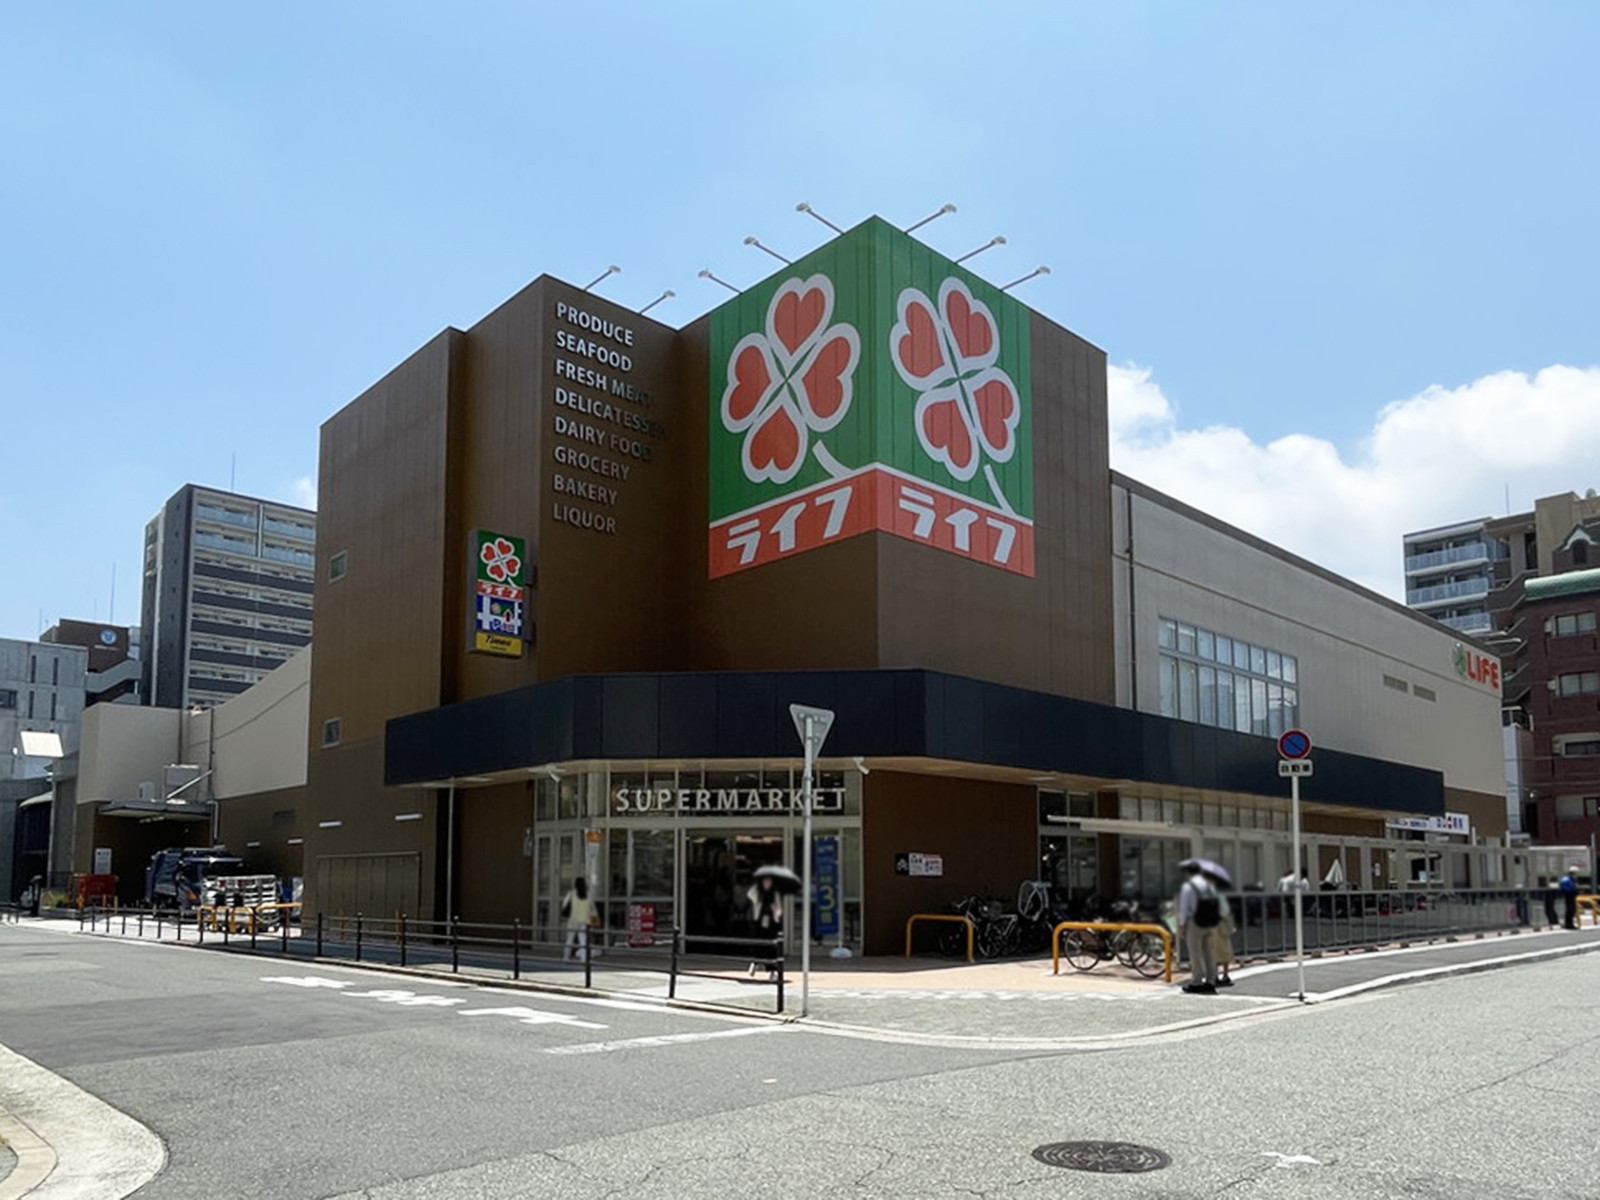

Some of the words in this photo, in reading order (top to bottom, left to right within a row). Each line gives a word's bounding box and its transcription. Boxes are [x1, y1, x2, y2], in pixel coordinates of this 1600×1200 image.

[556, 301, 634, 347] PRODUCE
[555, 330, 633, 373] SEAFOOD
[555, 358, 608, 391] FRESH
[554, 416, 606, 447] DAIRY
[554, 446, 630, 481] GROCERY
[553, 474, 618, 506] BAKERY
[552, 502, 617, 534] LIQUOR
[726, 485, 853, 565] ライフ
[898, 485, 1017, 565] ライフ
[1465, 649, 1499, 690] LIFE
[615, 787, 847, 812] SUPERMARKET
